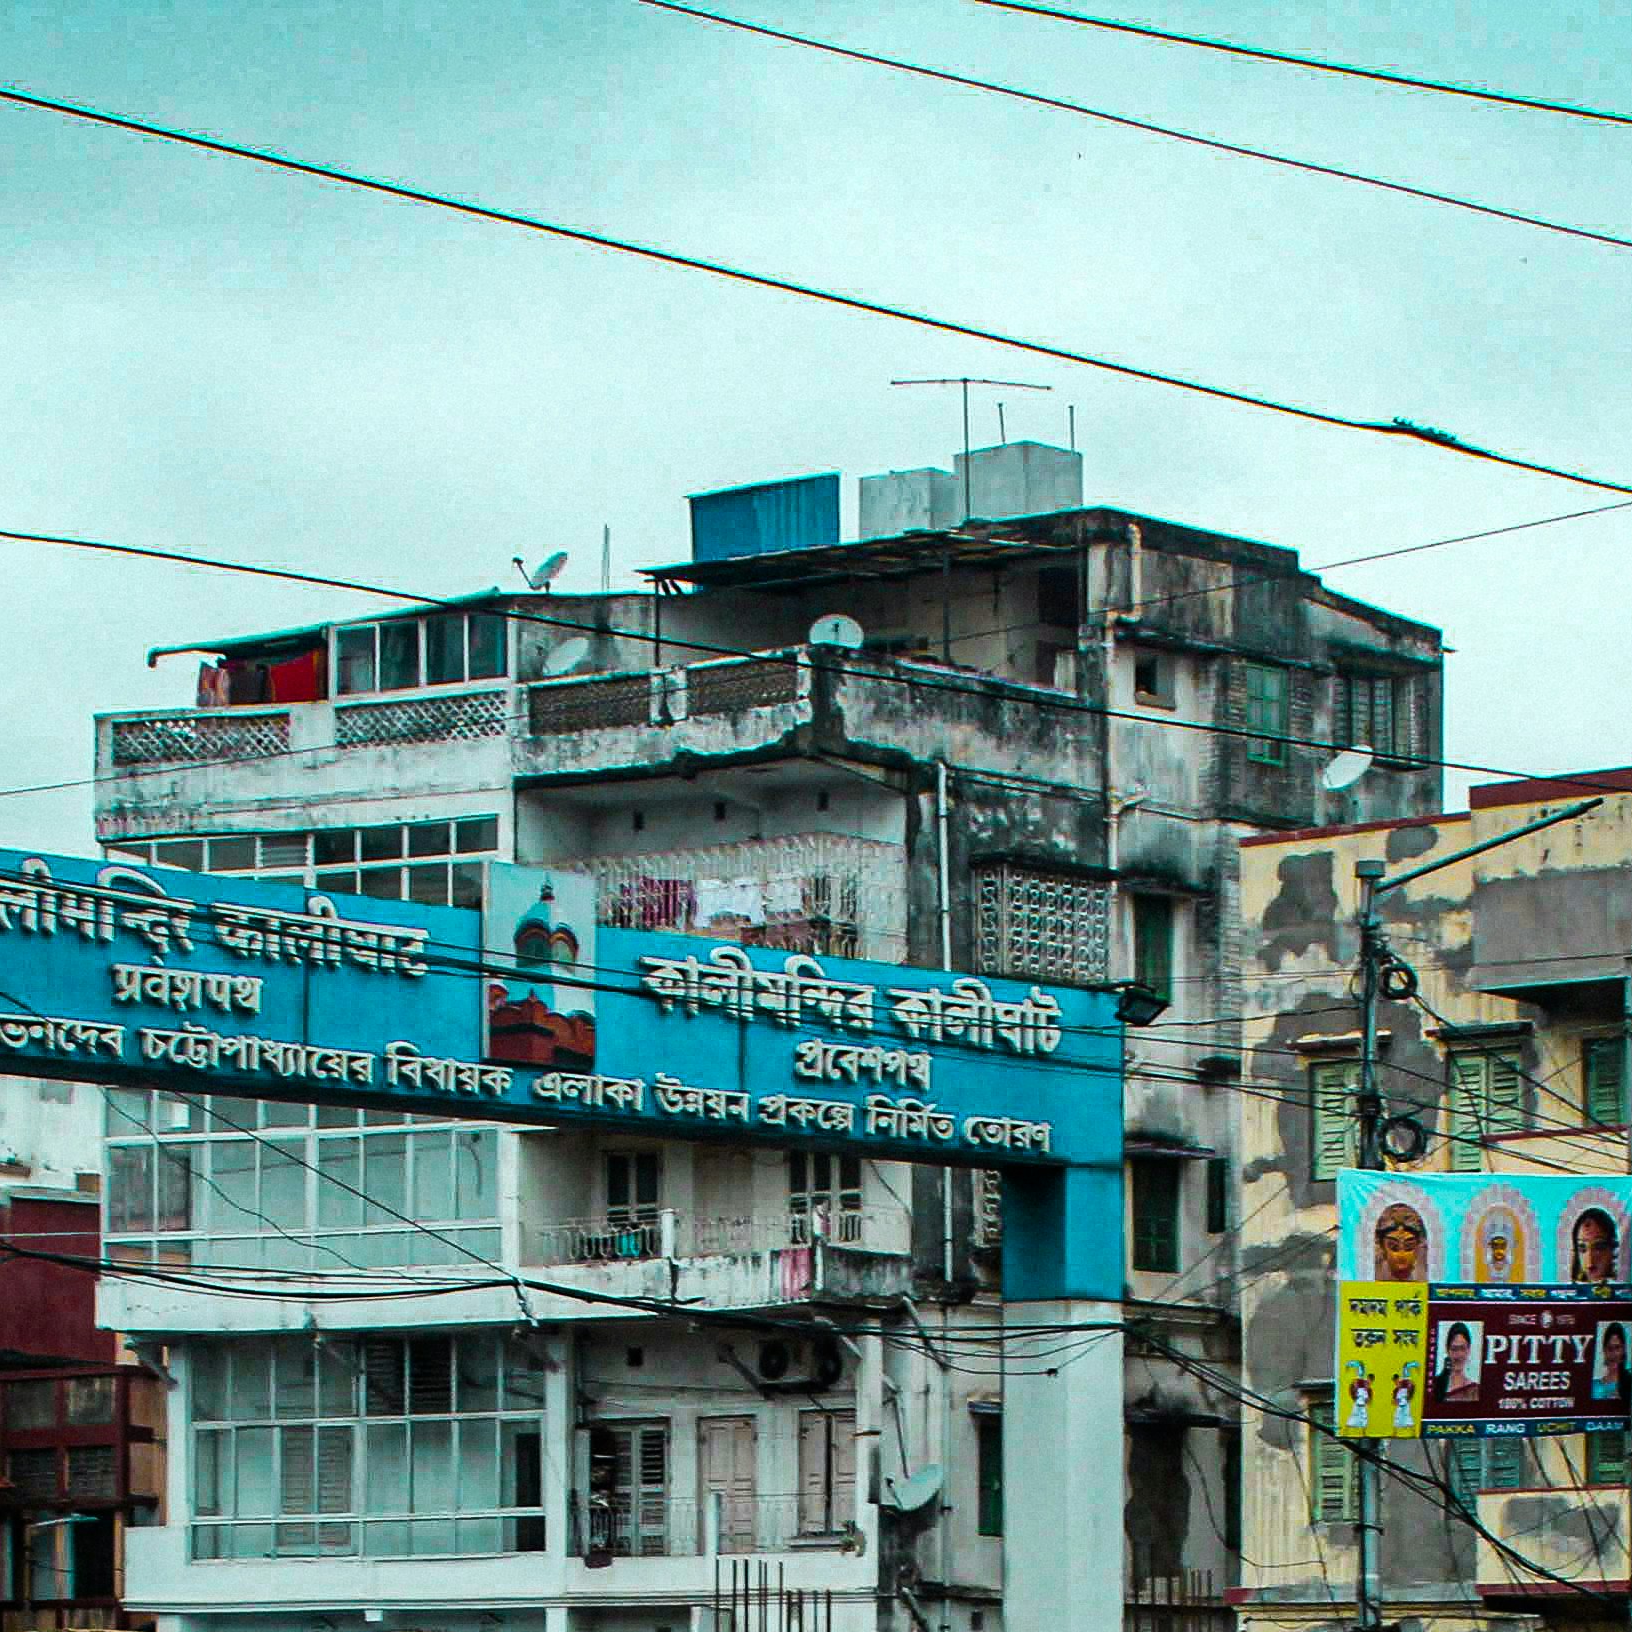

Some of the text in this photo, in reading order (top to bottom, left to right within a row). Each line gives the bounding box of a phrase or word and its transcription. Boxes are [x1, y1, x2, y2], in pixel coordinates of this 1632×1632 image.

[795, 1038, 933, 1091] প্রবেশপথ
[386, 1041, 514, 1097] বিধায়ক
[532, 1071, 646, 1112] এলাকা
[653, 1072, 751, 1122] উন্নয়ন
[864, 1094, 956, 1140] নির্মিত
[963, 1116, 1052, 1153] তোরণ
[1508, 1314, 1536, 1326] SINCE
[1484, 1334, 1595, 1365] PITTY
[1503, 1371, 1572, 1391] SAREES
[1497, 1396, 1575, 1410] 100% COTTON
[1426, 1423, 1475, 1435] PAKKA
[1485, 1422, 1526, 1434] RANG
[1536, 1421, 1575, 1433] UCHIT
